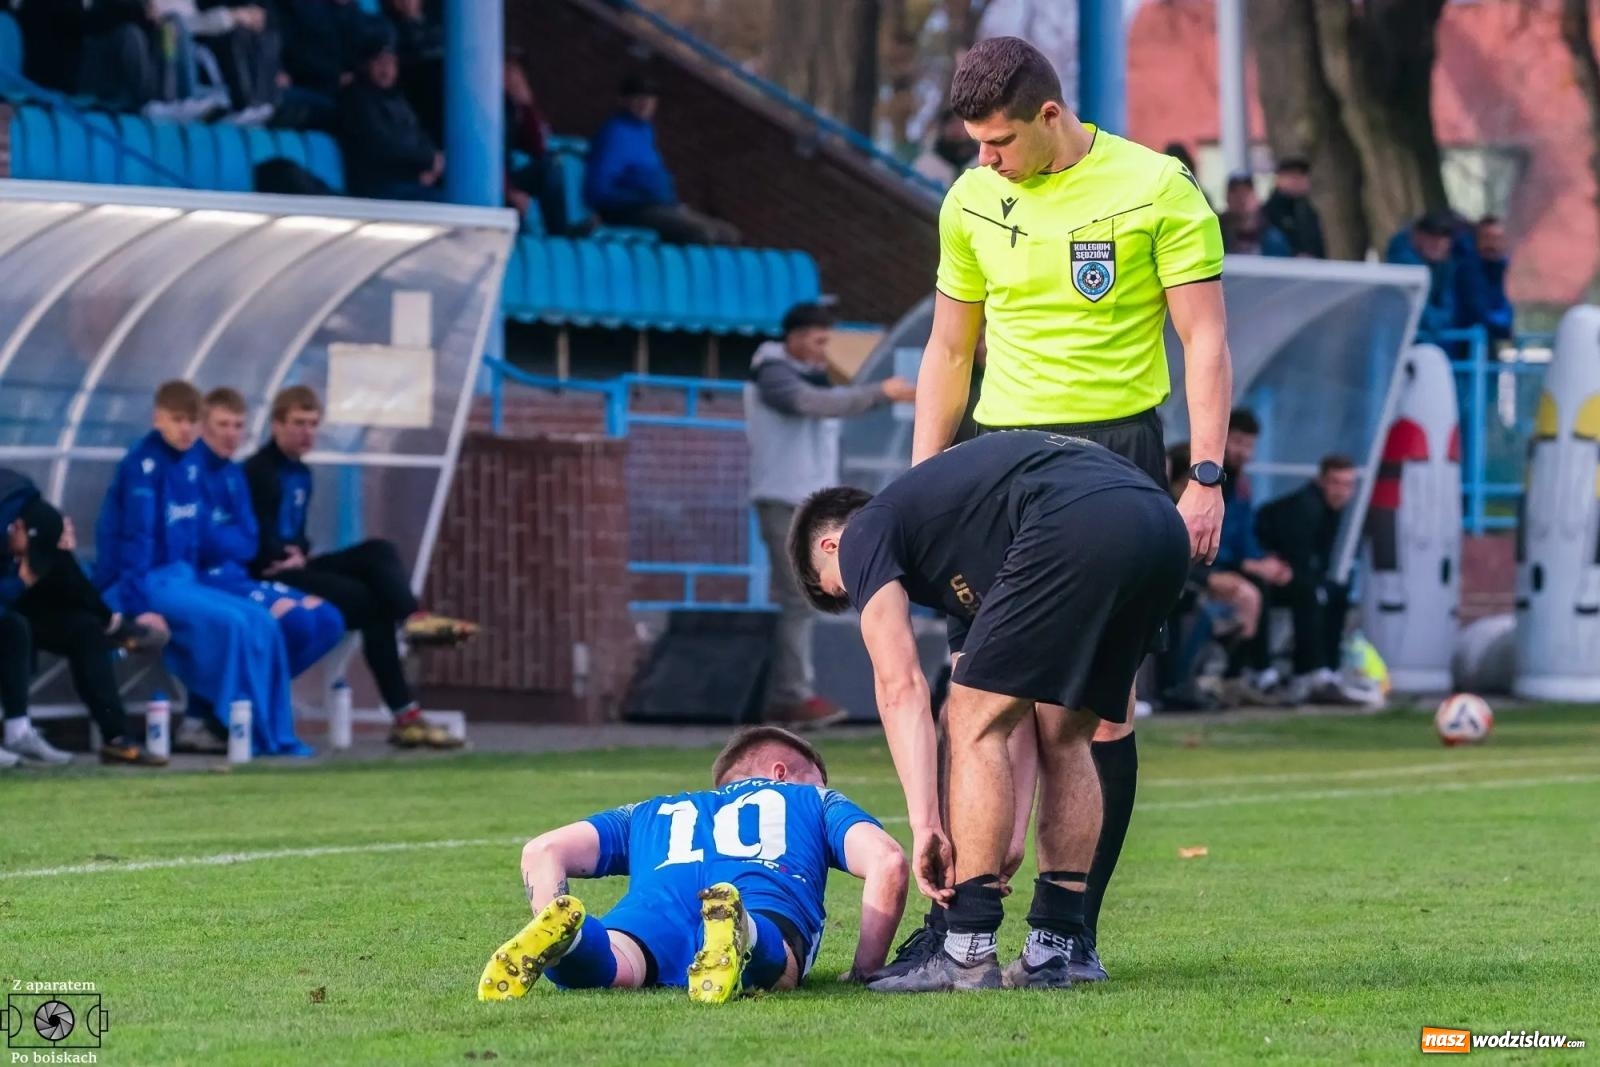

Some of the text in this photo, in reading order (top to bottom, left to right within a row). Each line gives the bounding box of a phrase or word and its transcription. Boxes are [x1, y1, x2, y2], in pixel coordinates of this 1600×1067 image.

[1074, 243, 1111, 251] KOLEGIUM
[1075, 251, 1110, 260] SĘDZIÓW
[655, 788, 787, 871] 10
